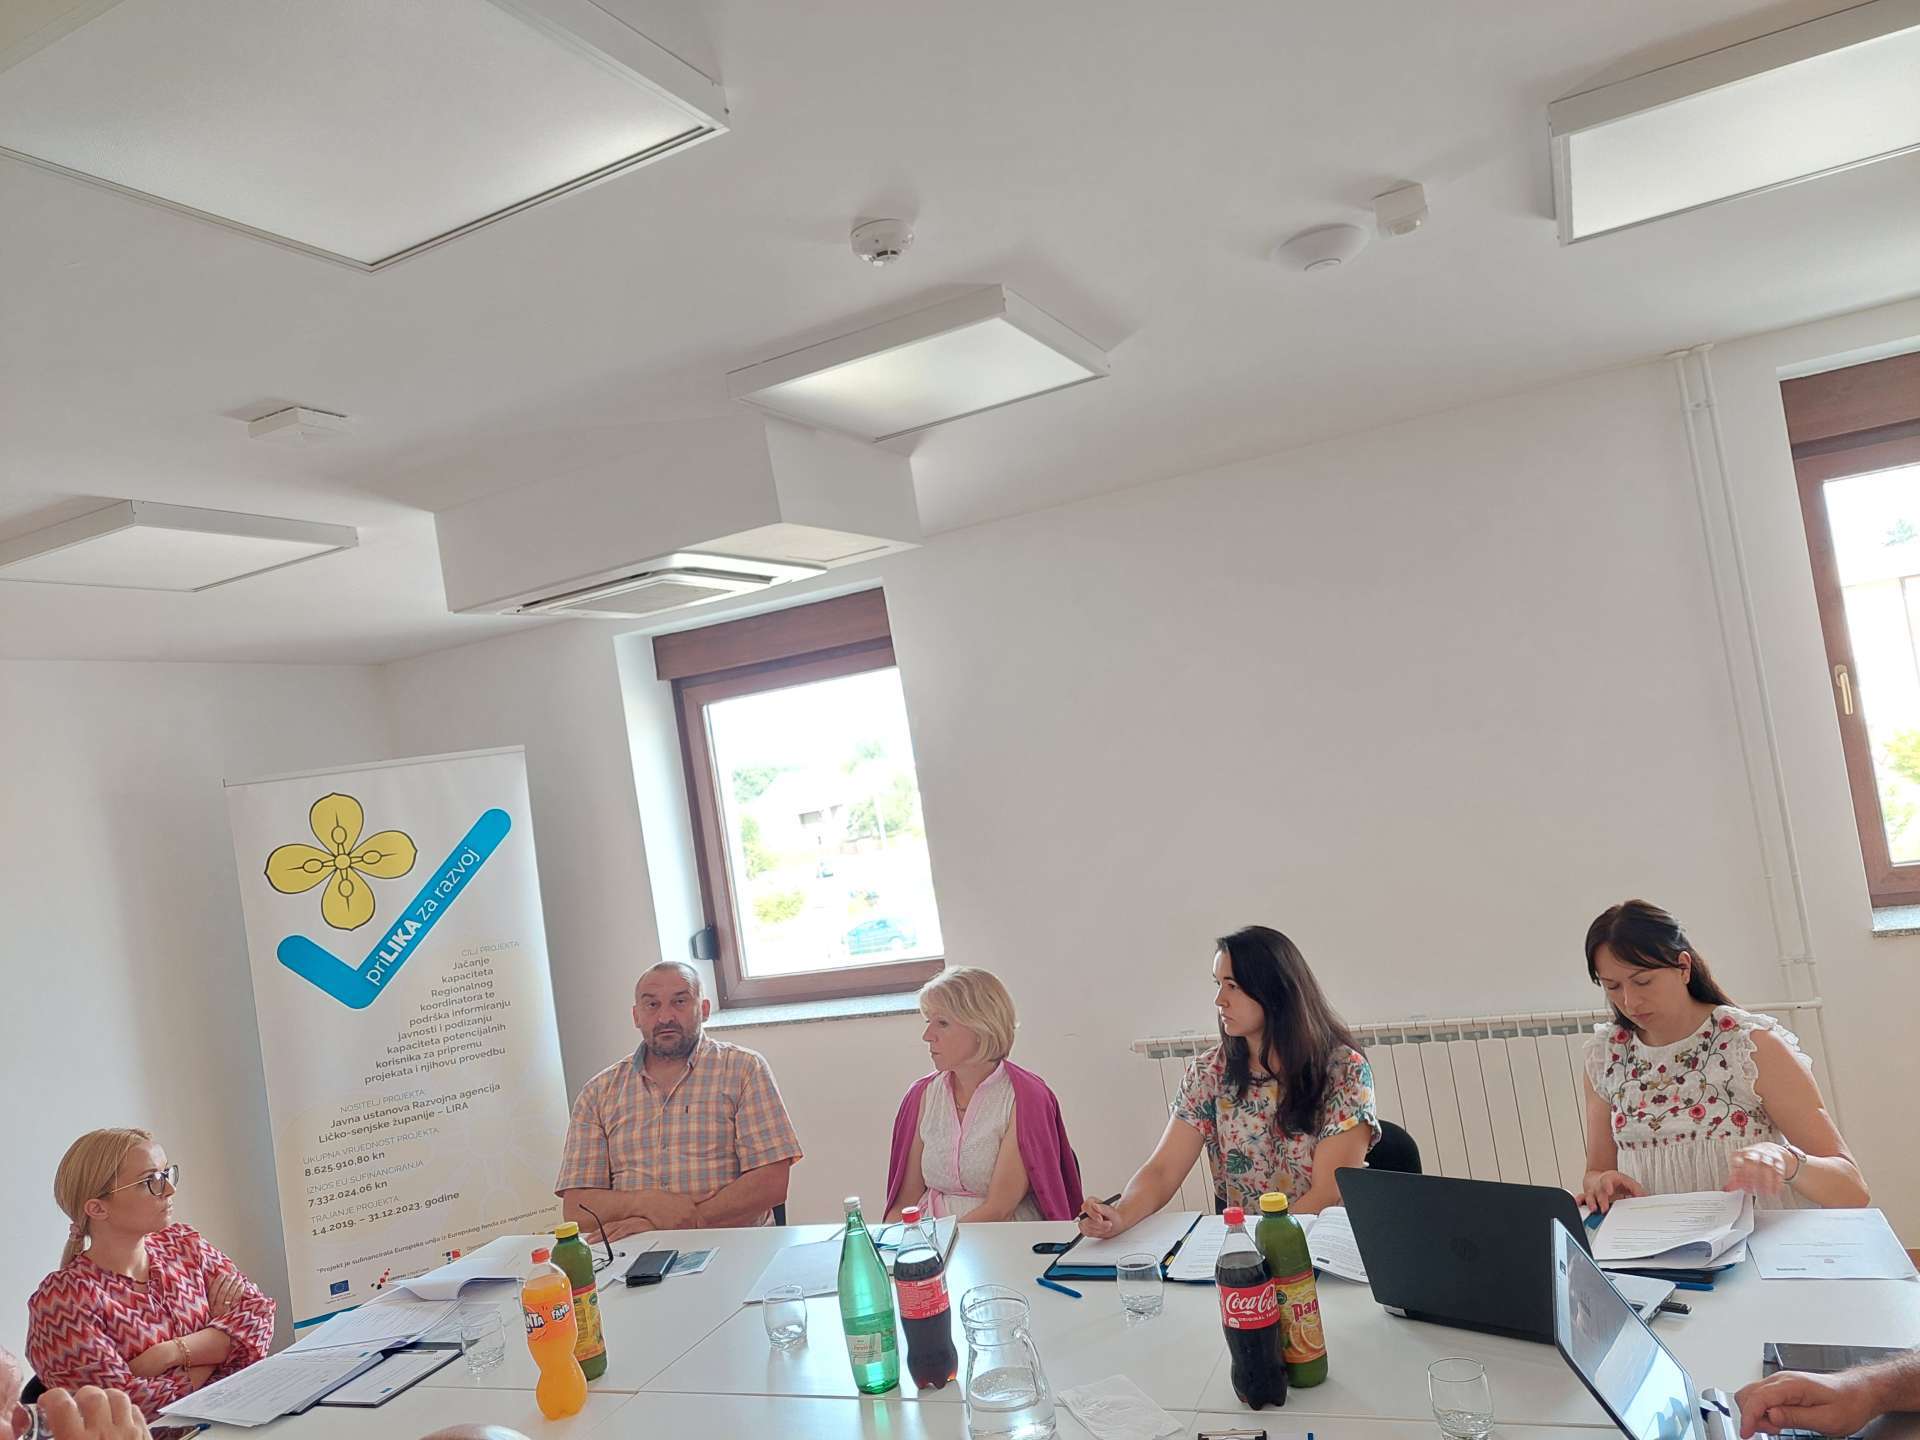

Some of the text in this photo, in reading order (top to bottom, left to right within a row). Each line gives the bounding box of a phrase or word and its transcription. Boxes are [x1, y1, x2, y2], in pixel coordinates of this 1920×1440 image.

[366, 846, 480, 986] priLIKA za razvoj
[480, 941, 520, 953] PROJEKTA
[442, 968, 494, 984] kapaciteta
[453, 957, 490, 970] Jačanje
[420, 993, 483, 1012] koordinatora
[431, 980, 493, 998] Regionalnog
[409, 1000, 511, 1028] podrška informiranju
[386, 1024, 506, 1055] kapaciteta potencijalnih
[398, 1027, 437, 1042] javnosti
[445, 1016, 492, 1033] podizanju
[365, 1067, 413, 1085] projekata
[421, 1058, 457, 1072] njihovu
[459, 1047, 505, 1065] provedbu
[376, 1041, 482, 1069] korisnika za pripremu
[330, 1083, 501, 1129] Javna ustanova Razvojna agencija
[340, 1088, 425, 1113] NOSITELJ PROJEKTA
[319, 1121, 390, 1144] Ličko-senjske
[393, 1109, 435, 1128] županije
[446, 1102, 469, 1114] LIRA
[303, 1127, 440, 1165] UKUPNA VRIJEDNOST PROJEKTA
[304, 1151, 385, 1177] 8.625.910,80 kn
[306, 1160, 424, 1194] IZNOS EU SUFINANCIRANJA
[375, 1180, 388, 1190] kn
[311, 1196, 400, 1225] TRAJANJE PROJEKTA
[312, 1220, 357, 1236] 1.4.2019.
[368, 1202, 423, 1222] 31.12.2023.
[425, 1191, 460, 1209] godine
[352, 1250, 393, 1264] sufinancirala
[394, 1241, 423, 1254] Europska
[425, 1237, 441, 1246] unija
[447, 1226, 480, 1239] Europskog
[1226, 1284, 1277, 1315] Coca-Col
